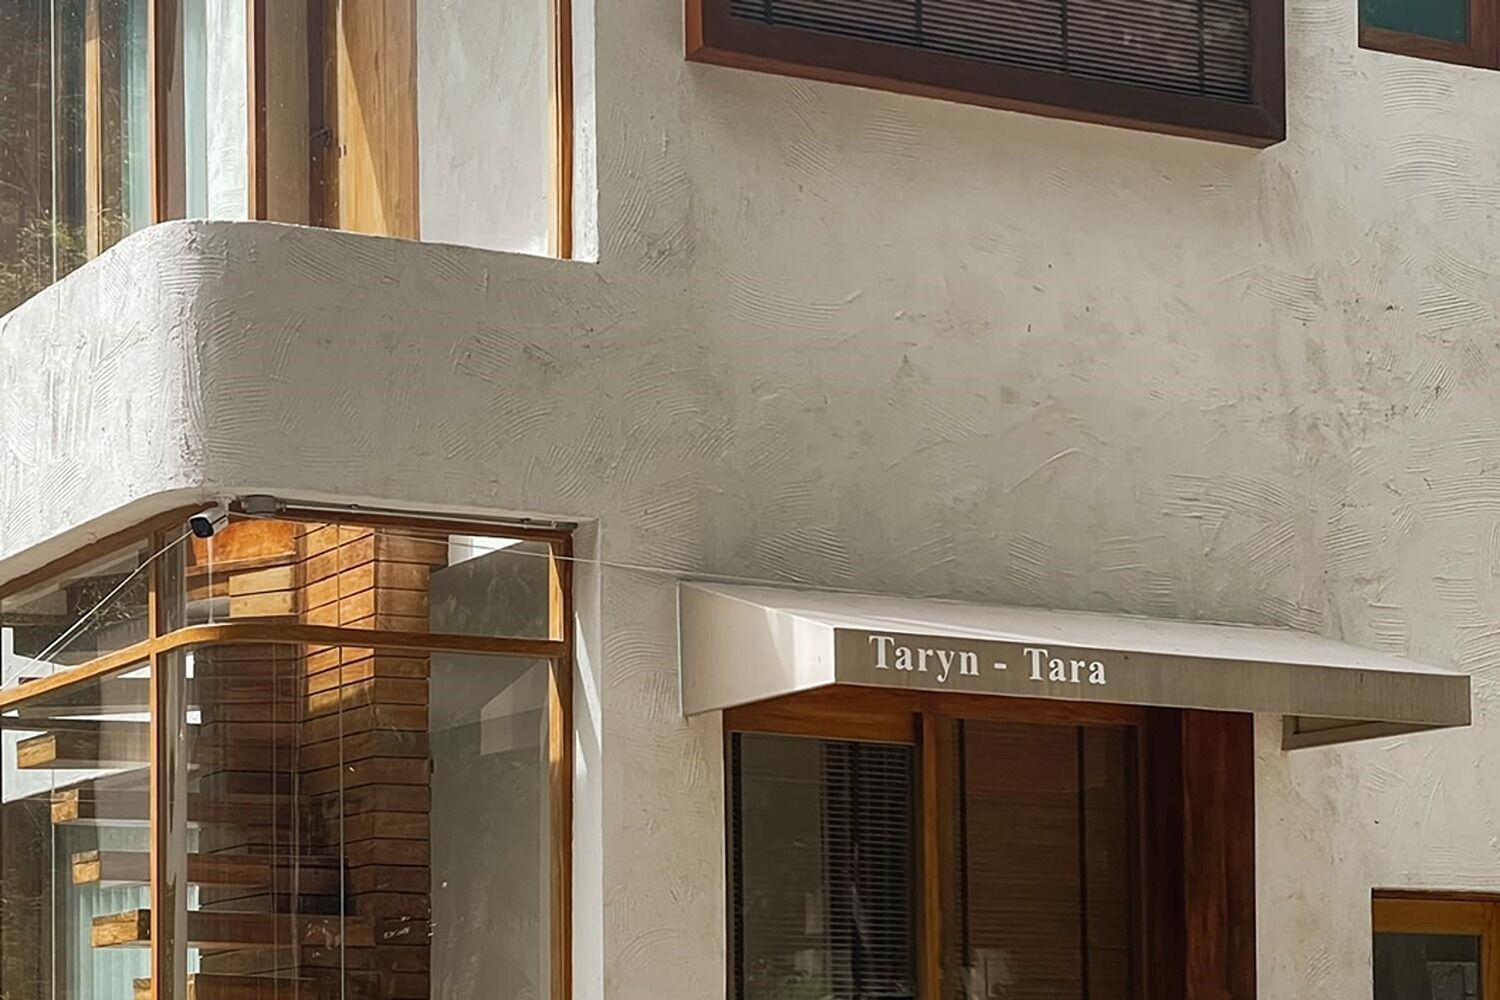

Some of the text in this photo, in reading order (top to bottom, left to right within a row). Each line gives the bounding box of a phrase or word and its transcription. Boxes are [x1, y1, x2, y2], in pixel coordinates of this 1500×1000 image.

[868, 635, 1107, 685] Taryn - Tara
